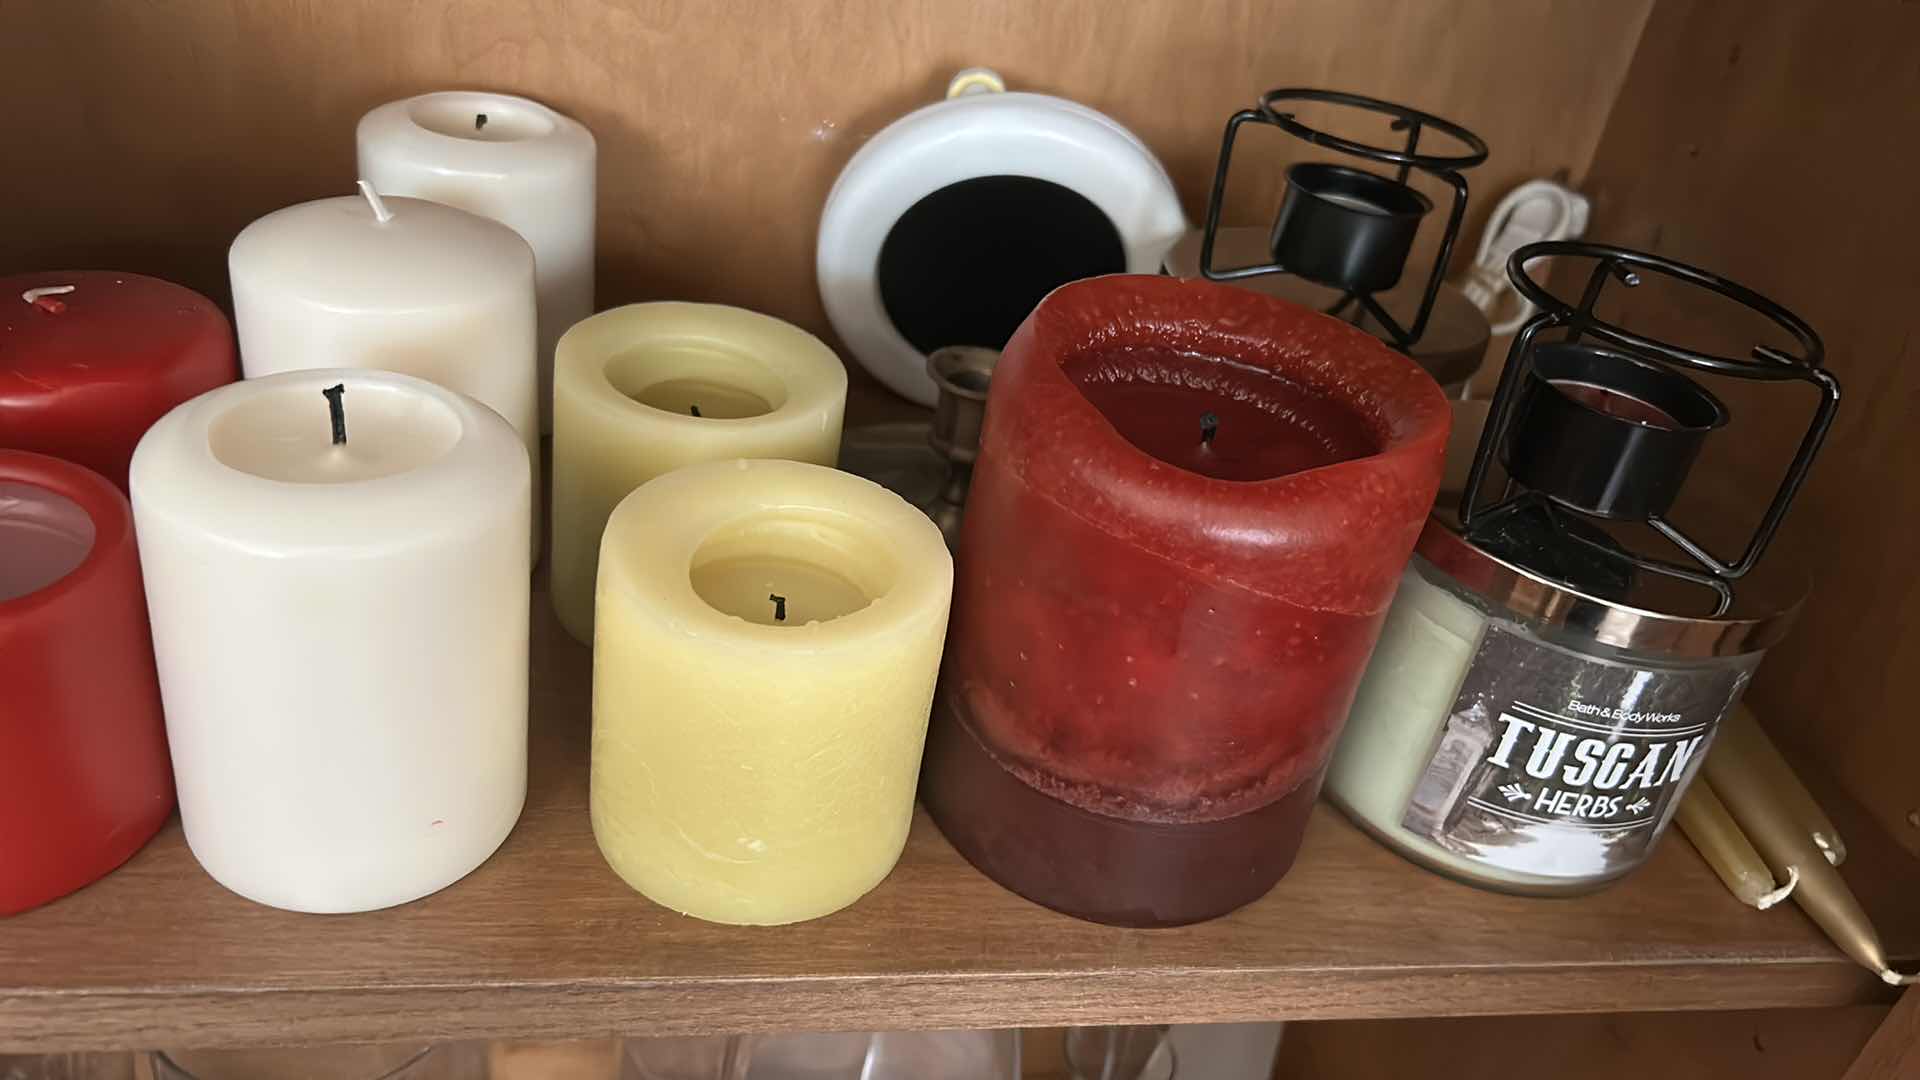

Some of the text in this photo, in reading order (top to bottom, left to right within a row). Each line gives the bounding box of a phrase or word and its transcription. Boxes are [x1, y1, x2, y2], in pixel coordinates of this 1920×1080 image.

[1567, 699, 1681, 724] Bath & Body Works
[1487, 712, 1704, 790] TUSCAN
[1534, 787, 1622, 818] HERBS
